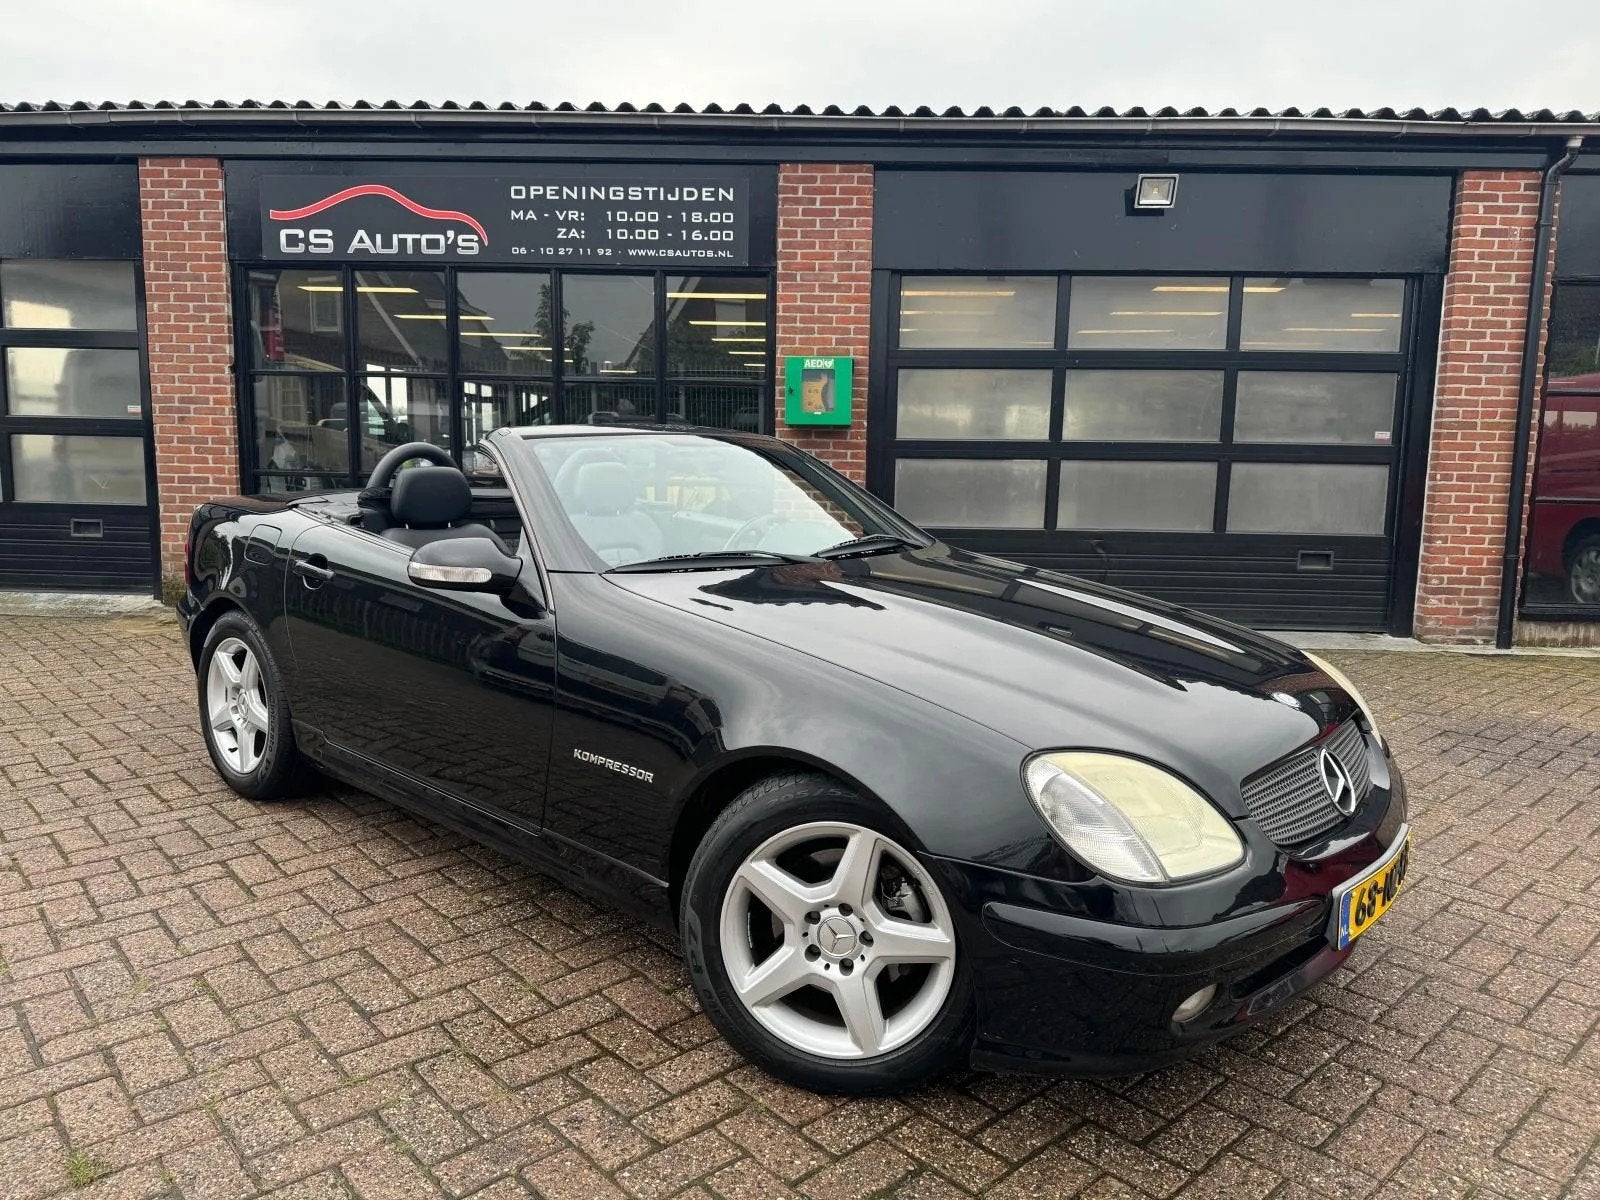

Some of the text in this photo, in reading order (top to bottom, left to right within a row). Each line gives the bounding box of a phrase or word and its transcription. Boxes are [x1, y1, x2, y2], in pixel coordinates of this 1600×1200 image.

[510, 185, 734, 202] OPENINGSTIJDEN
[510, 209, 538, 221] MA
[554, 209, 585, 222] VR:
[606, 210, 659, 223] 10.00
[680, 211, 734, 224] 18.00
[279, 228, 334, 254] CS
[556, 227, 585, 239] ZA:
[606, 228, 660, 241] 10.00
[680, 229, 734, 242] 16.00
[511, 246, 527, 255] 06
[539, 247, 554, 255] 10
[558, 247, 574, 256] 27
[578, 248, 591, 256] 11
[596, 248, 613, 256] 92
[627, 248, 734, 258] WWW.CSAUTOS.NL
[804, 359, 823, 368] AED
[573, 748, 654, 784] KOMPRESSOR
